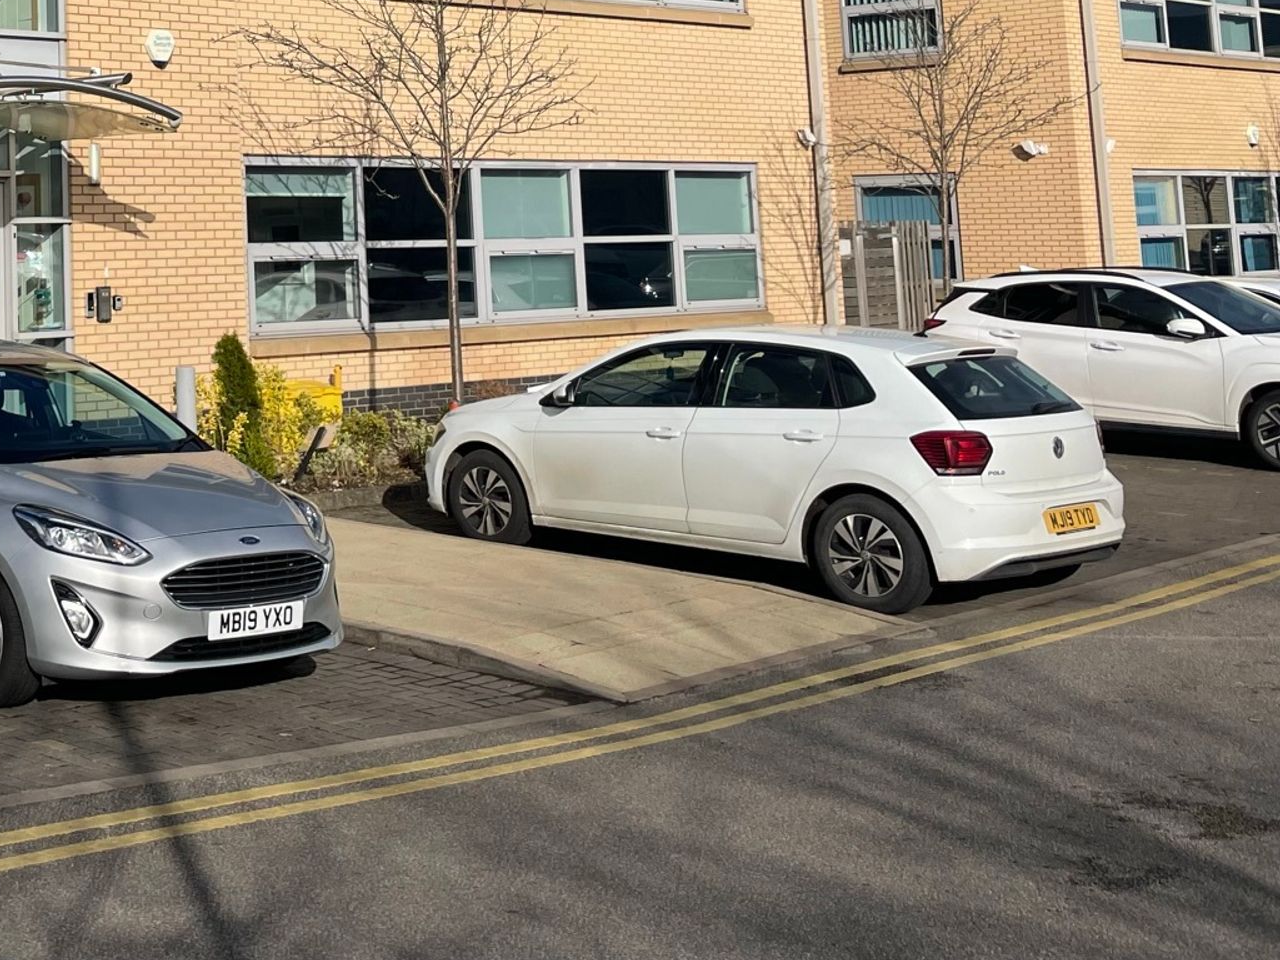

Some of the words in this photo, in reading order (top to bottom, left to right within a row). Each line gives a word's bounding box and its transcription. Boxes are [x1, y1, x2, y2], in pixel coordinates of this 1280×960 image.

[1050, 510, 1073, 530] MJ19
[1074, 507, 1094, 526] TYD
[220, 610, 257, 634] MB19
[263, 605, 293, 629] YXO
